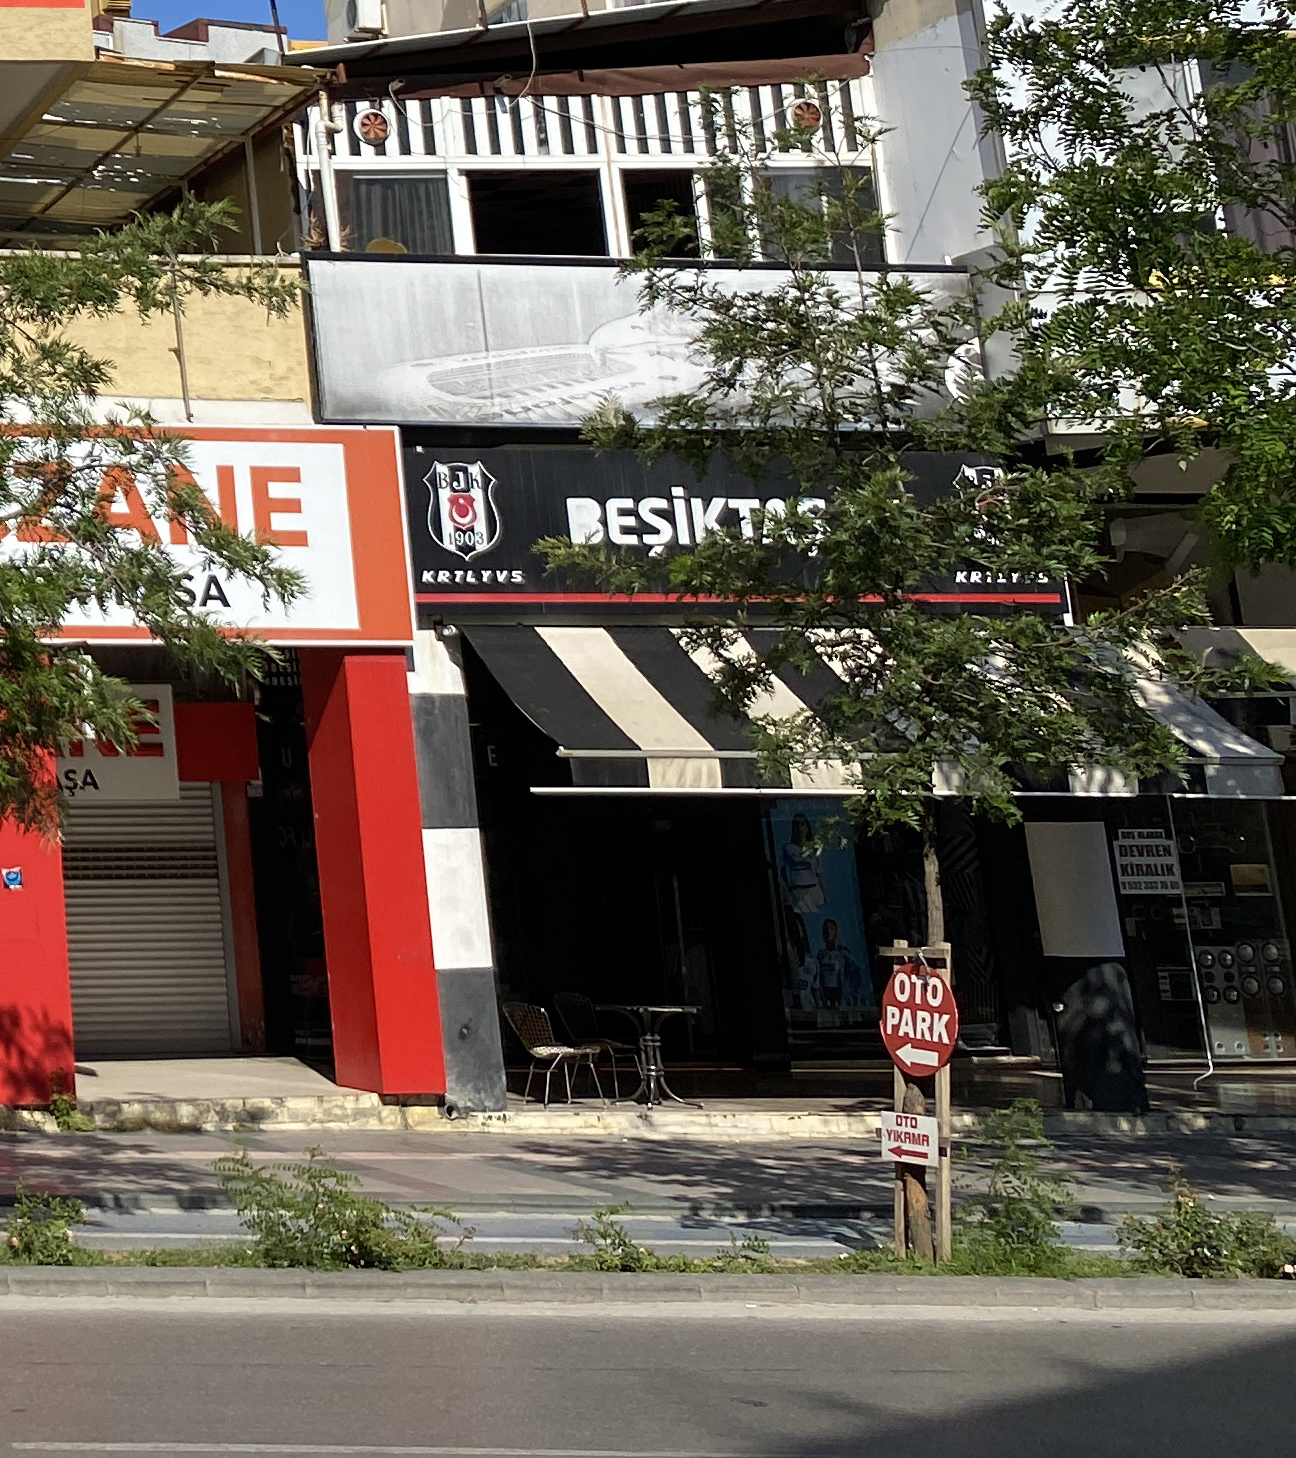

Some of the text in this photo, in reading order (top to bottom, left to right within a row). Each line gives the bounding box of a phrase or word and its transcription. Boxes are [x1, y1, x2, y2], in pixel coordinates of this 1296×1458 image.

[448, 531, 485, 546] 1903
[1118, 844, 1172, 857] DEVREN
[1120, 861, 1176, 876] KİRALIK
[893, 972, 944, 1007] OTO
[886, 1005, 951, 1044] PARK
[895, 1114, 918, 1129] OTO
[885, 1128, 930, 1147] YIKAMA
